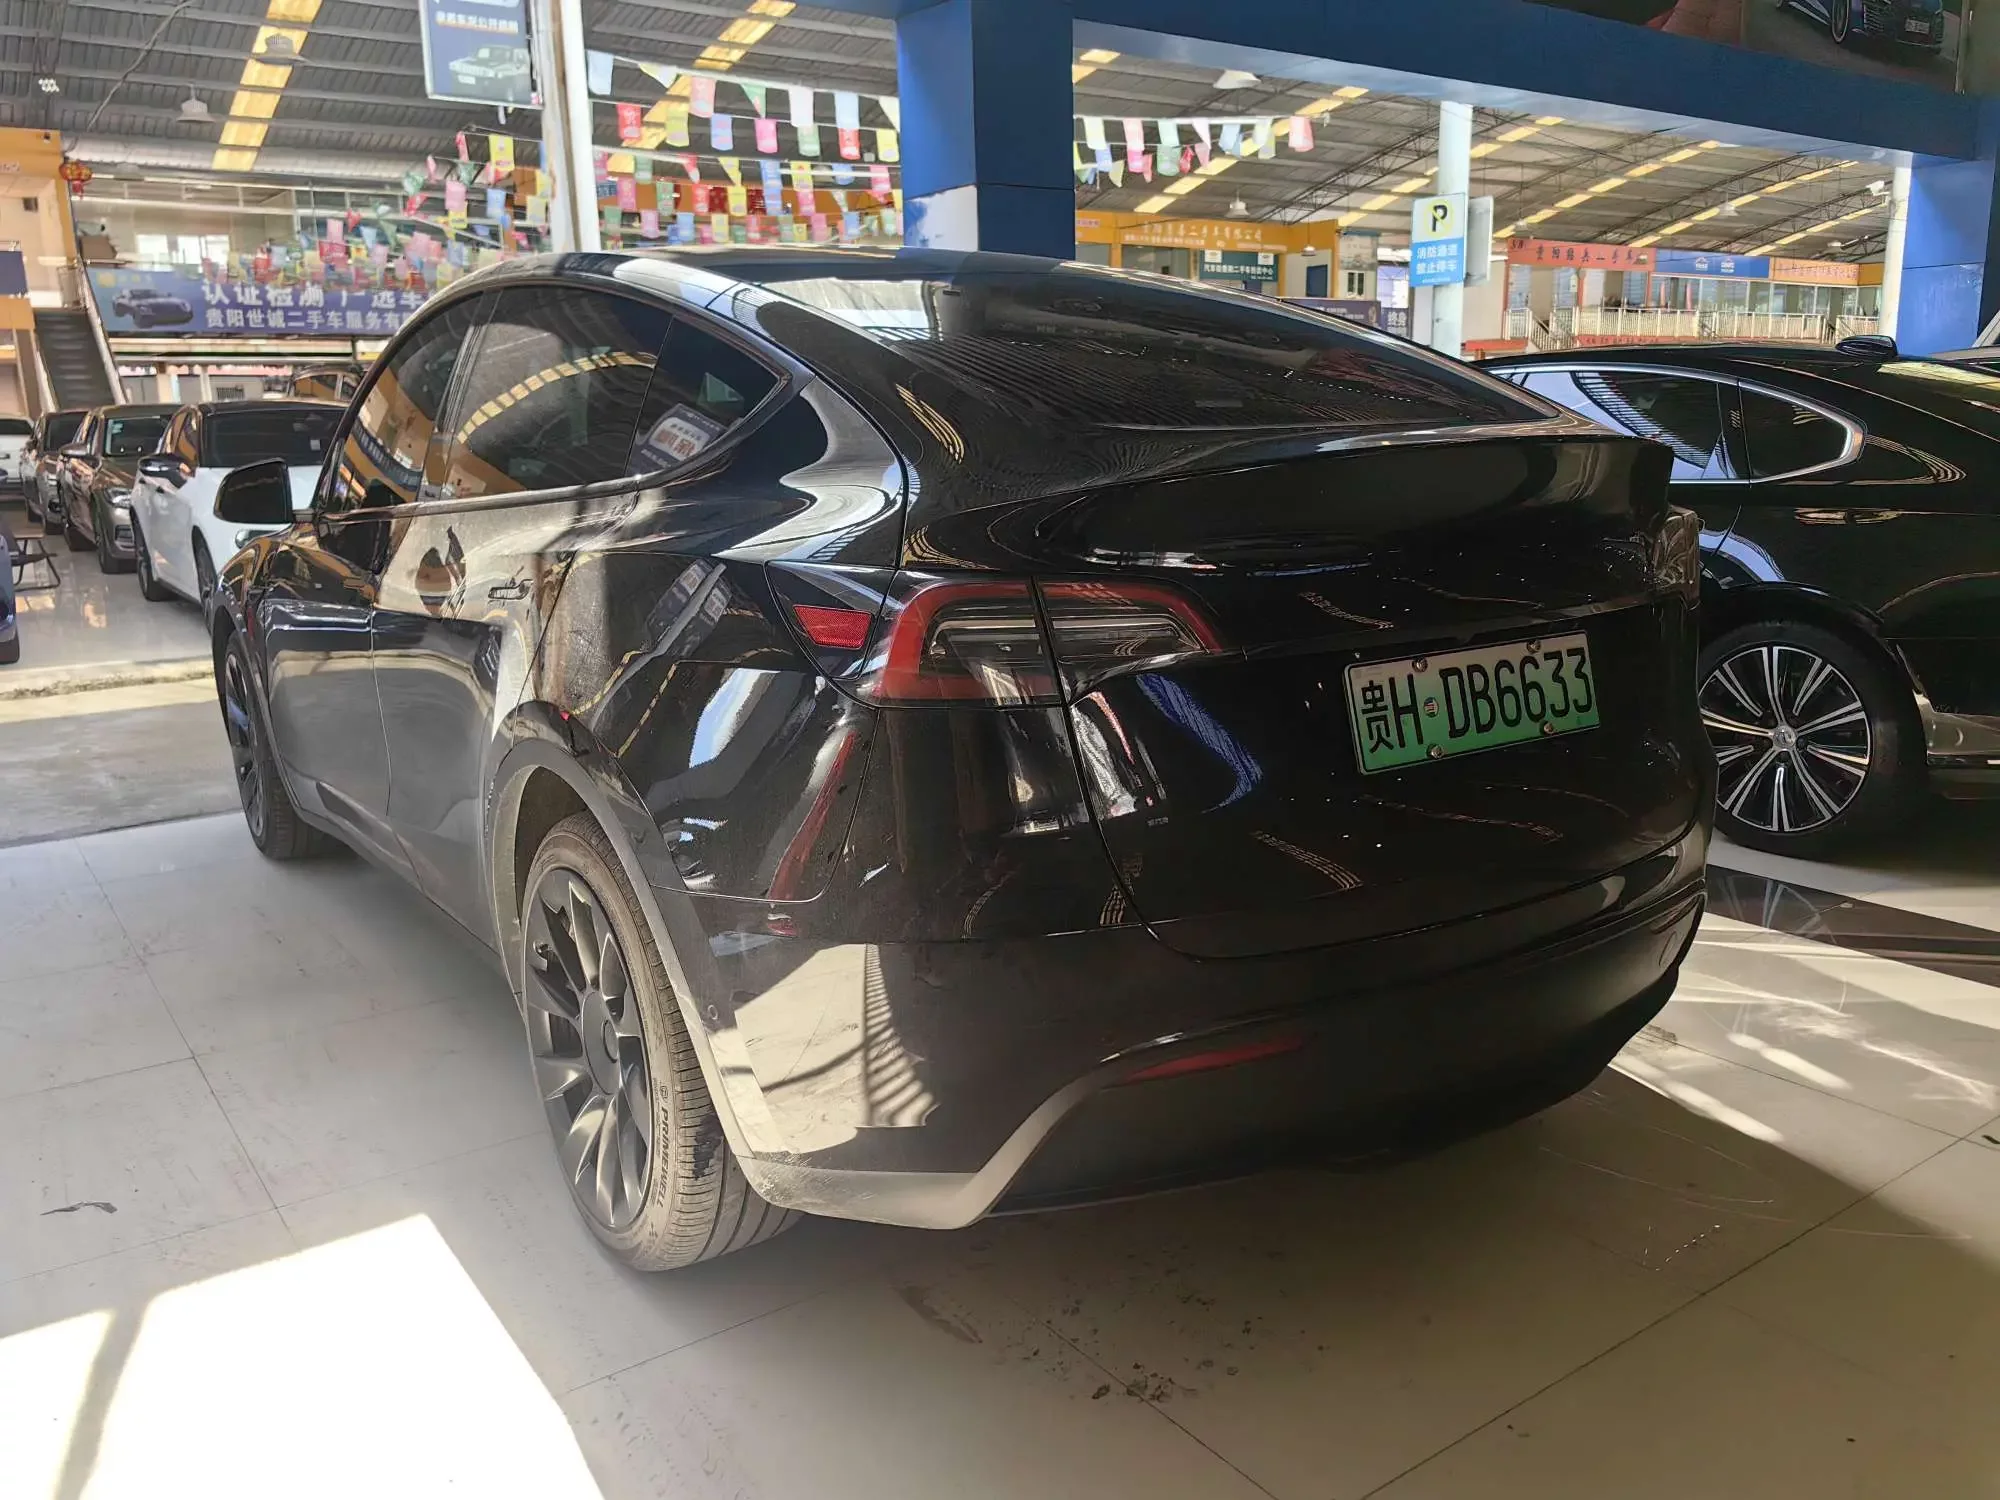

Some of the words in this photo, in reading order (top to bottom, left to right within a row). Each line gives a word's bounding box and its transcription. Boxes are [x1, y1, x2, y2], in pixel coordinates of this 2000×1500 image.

[1416, 243, 1458, 260] 消防通道
[1415, 260, 1457, 275] 禁止停车
[201, 280, 324, 308] 认证检测
[656, 1106, 669, 1208] PRIMEWELL
